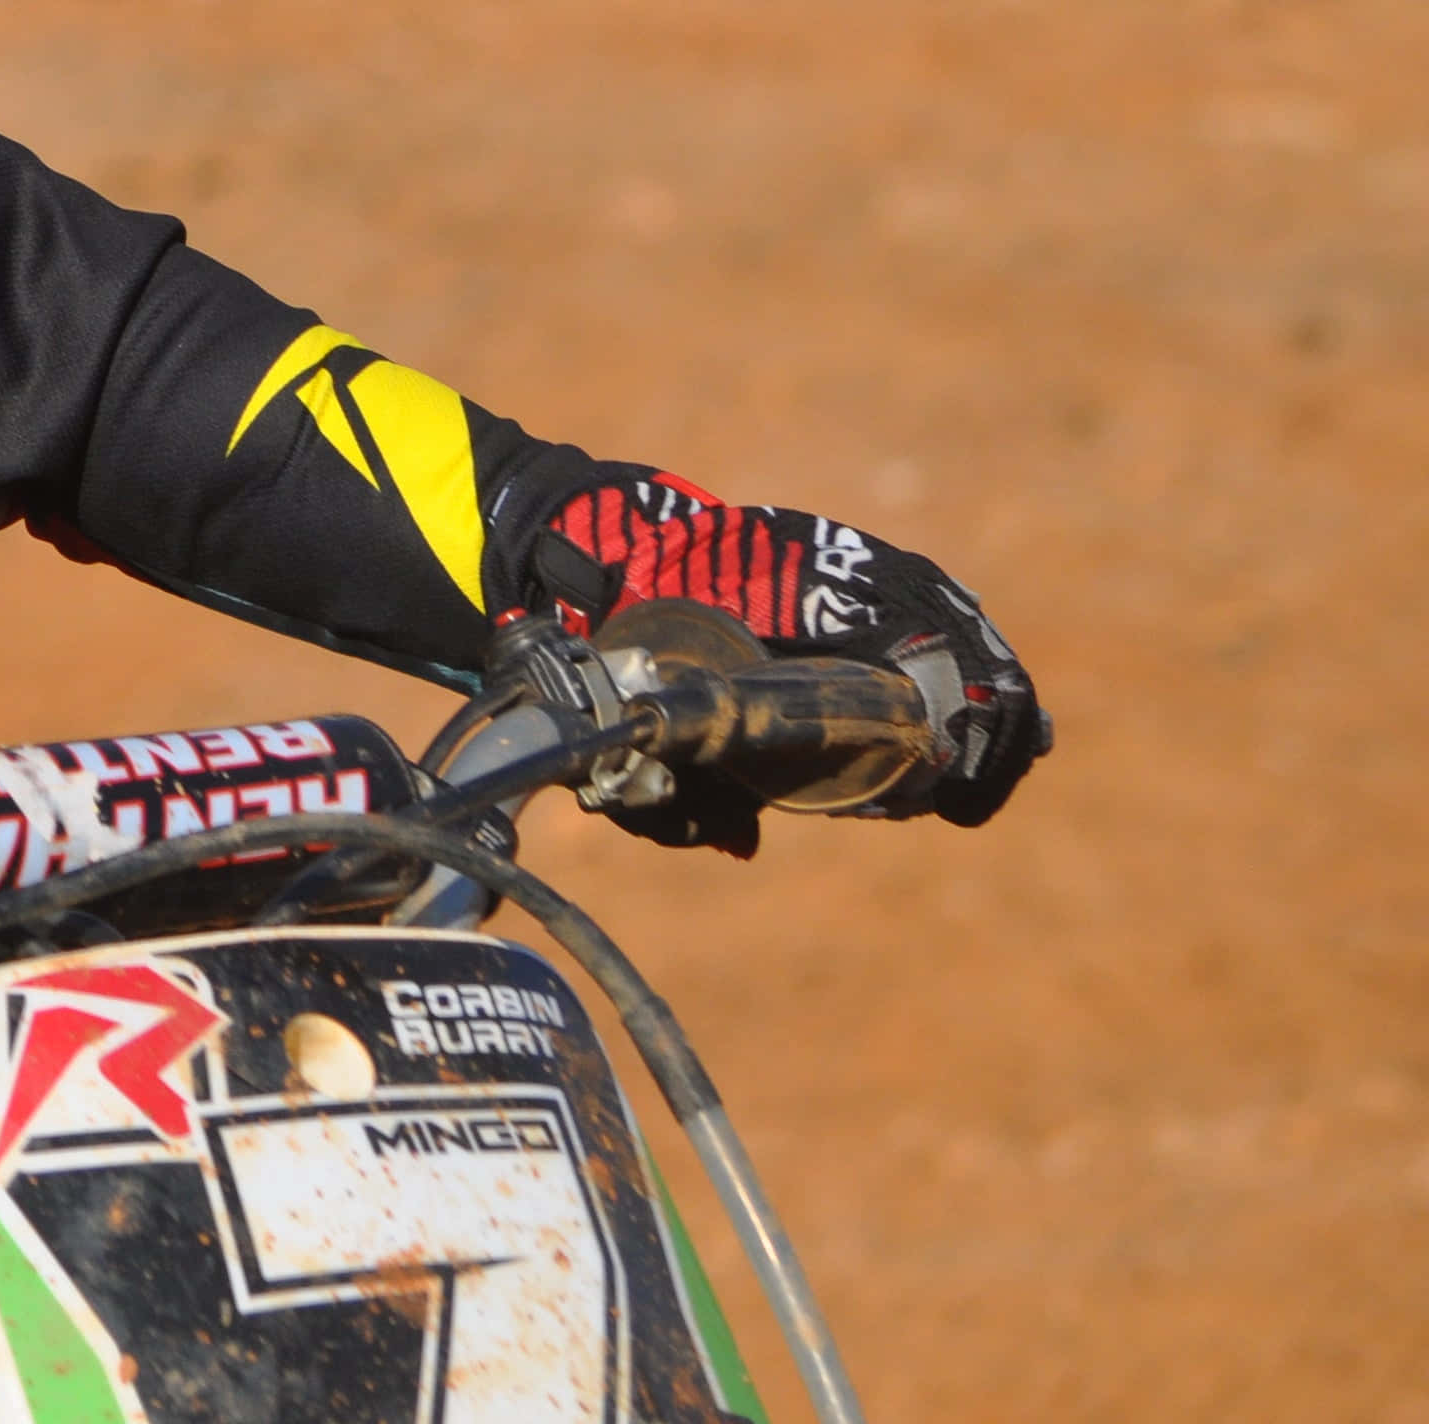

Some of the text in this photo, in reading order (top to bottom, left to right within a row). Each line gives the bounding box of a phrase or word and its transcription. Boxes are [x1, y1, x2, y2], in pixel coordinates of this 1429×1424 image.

[381, 980, 566, 1028] CORBIN
[391, 1017, 556, 1060] BURRY
[362, 1119, 560, 1157] MINGO
